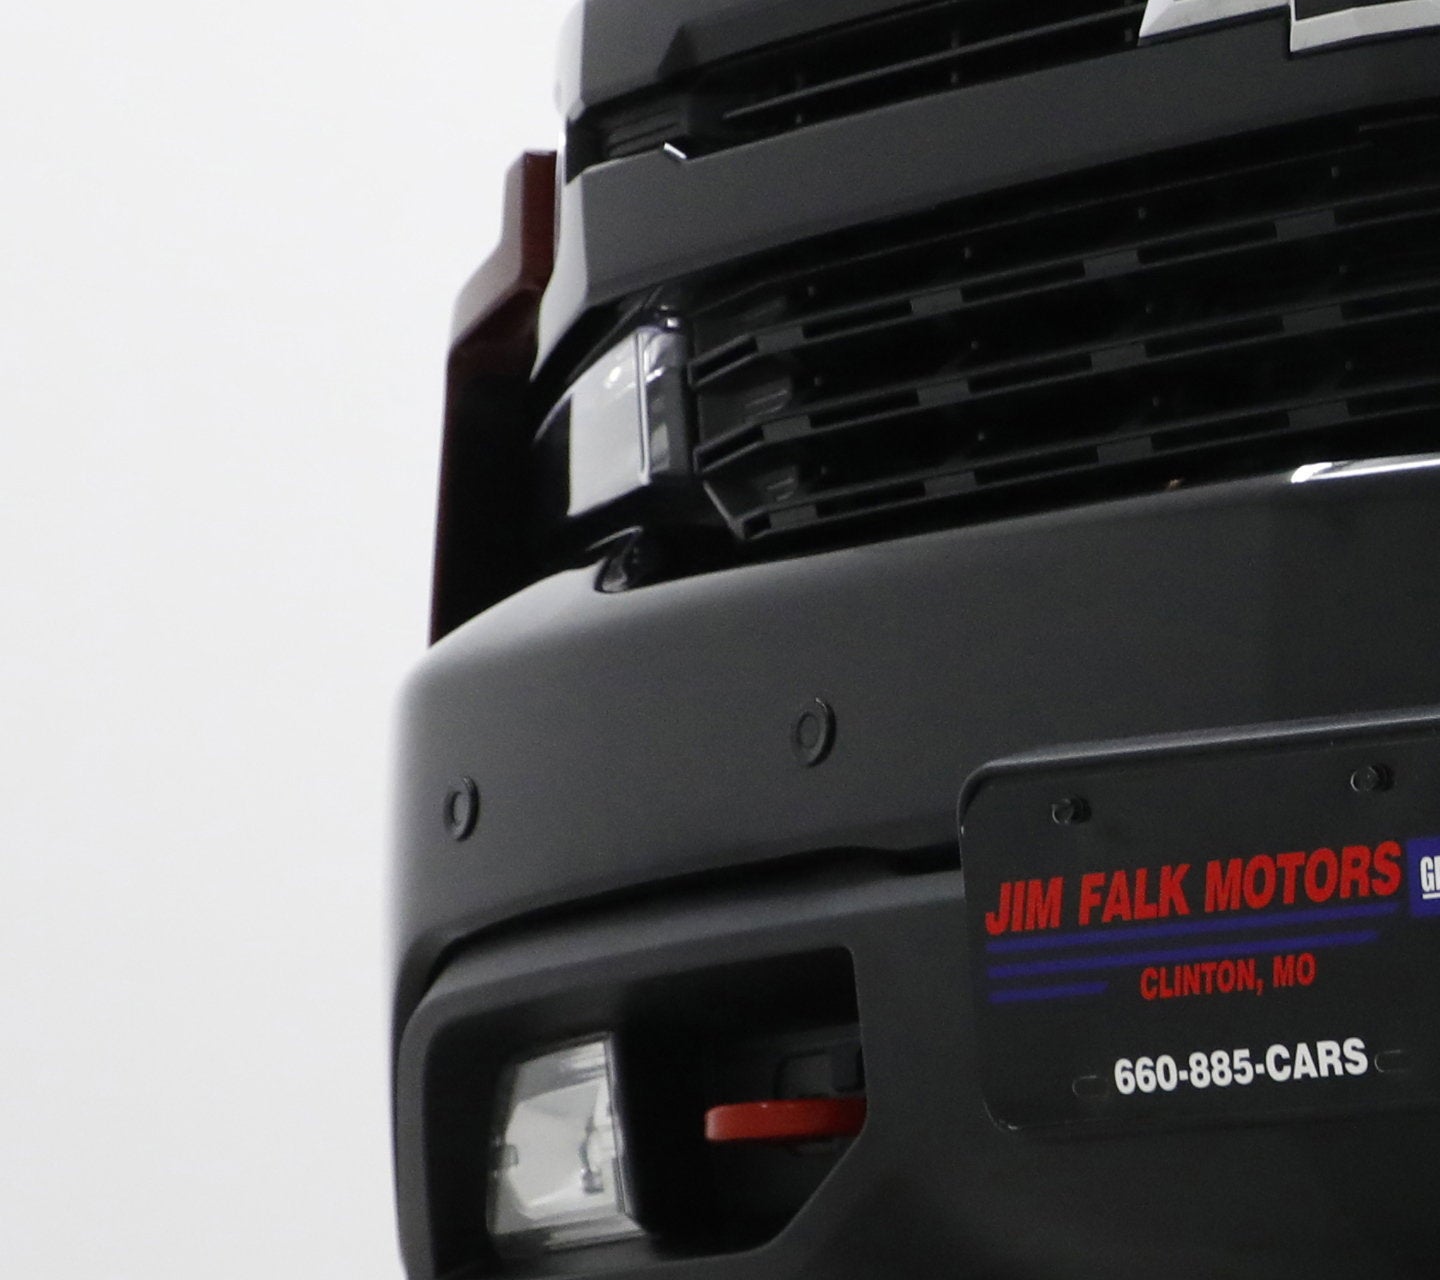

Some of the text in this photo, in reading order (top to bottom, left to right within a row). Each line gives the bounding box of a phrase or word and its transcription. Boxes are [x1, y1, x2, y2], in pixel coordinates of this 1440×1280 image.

[985, 840, 1403, 936] JIM FALK MOTORS
[1140, 952, 1317, 1001] CLINTON, MO
[1114, 1038, 1368, 1095] 660-885-CARS
